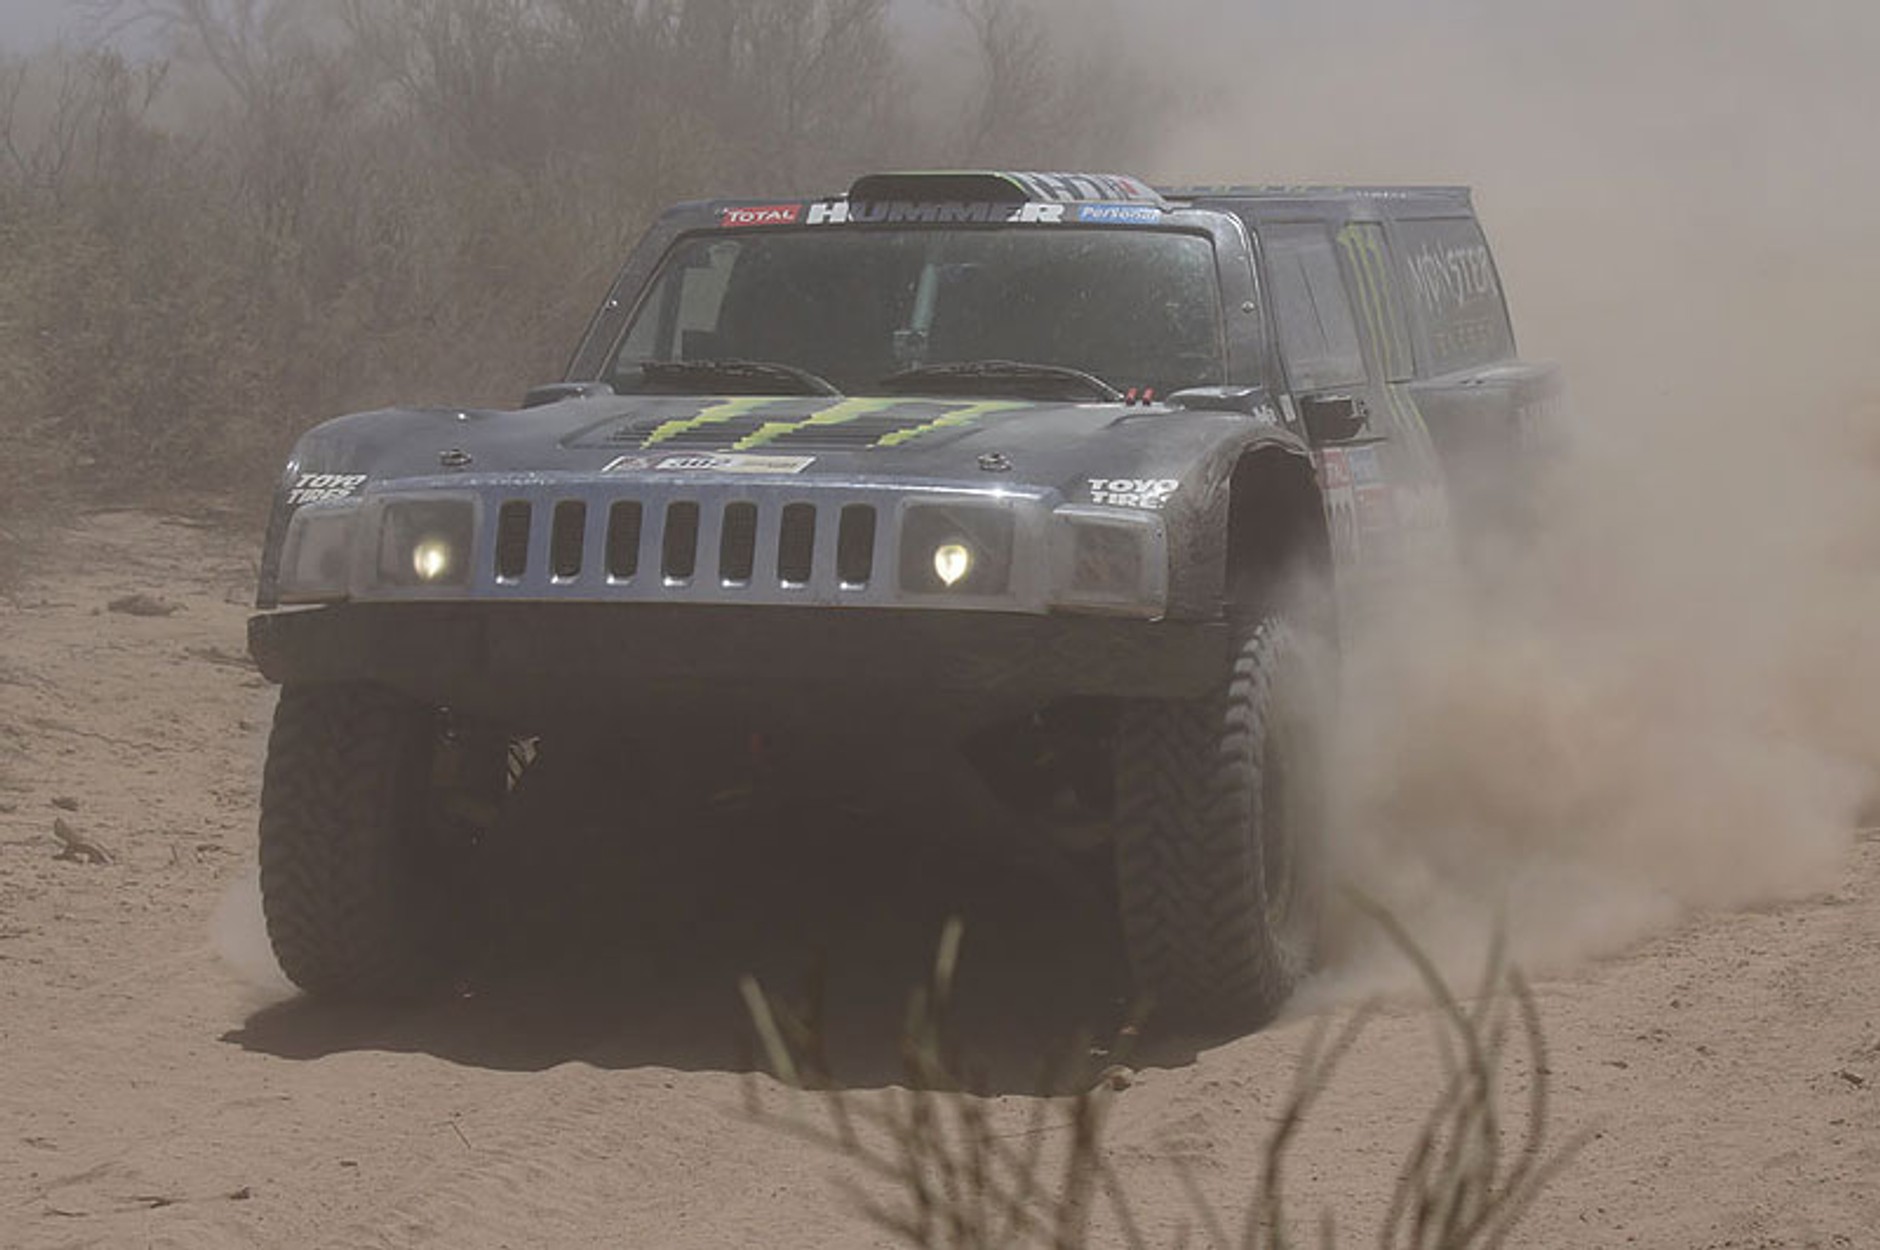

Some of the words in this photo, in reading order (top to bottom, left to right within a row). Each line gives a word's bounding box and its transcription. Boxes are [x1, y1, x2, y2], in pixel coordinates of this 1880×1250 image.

[729, 208, 796, 222] TOTAL
[806, 202, 1065, 224] HUMMER
[296, 474, 367, 488] TOYO
[1088, 479, 1179, 493] TOYO
